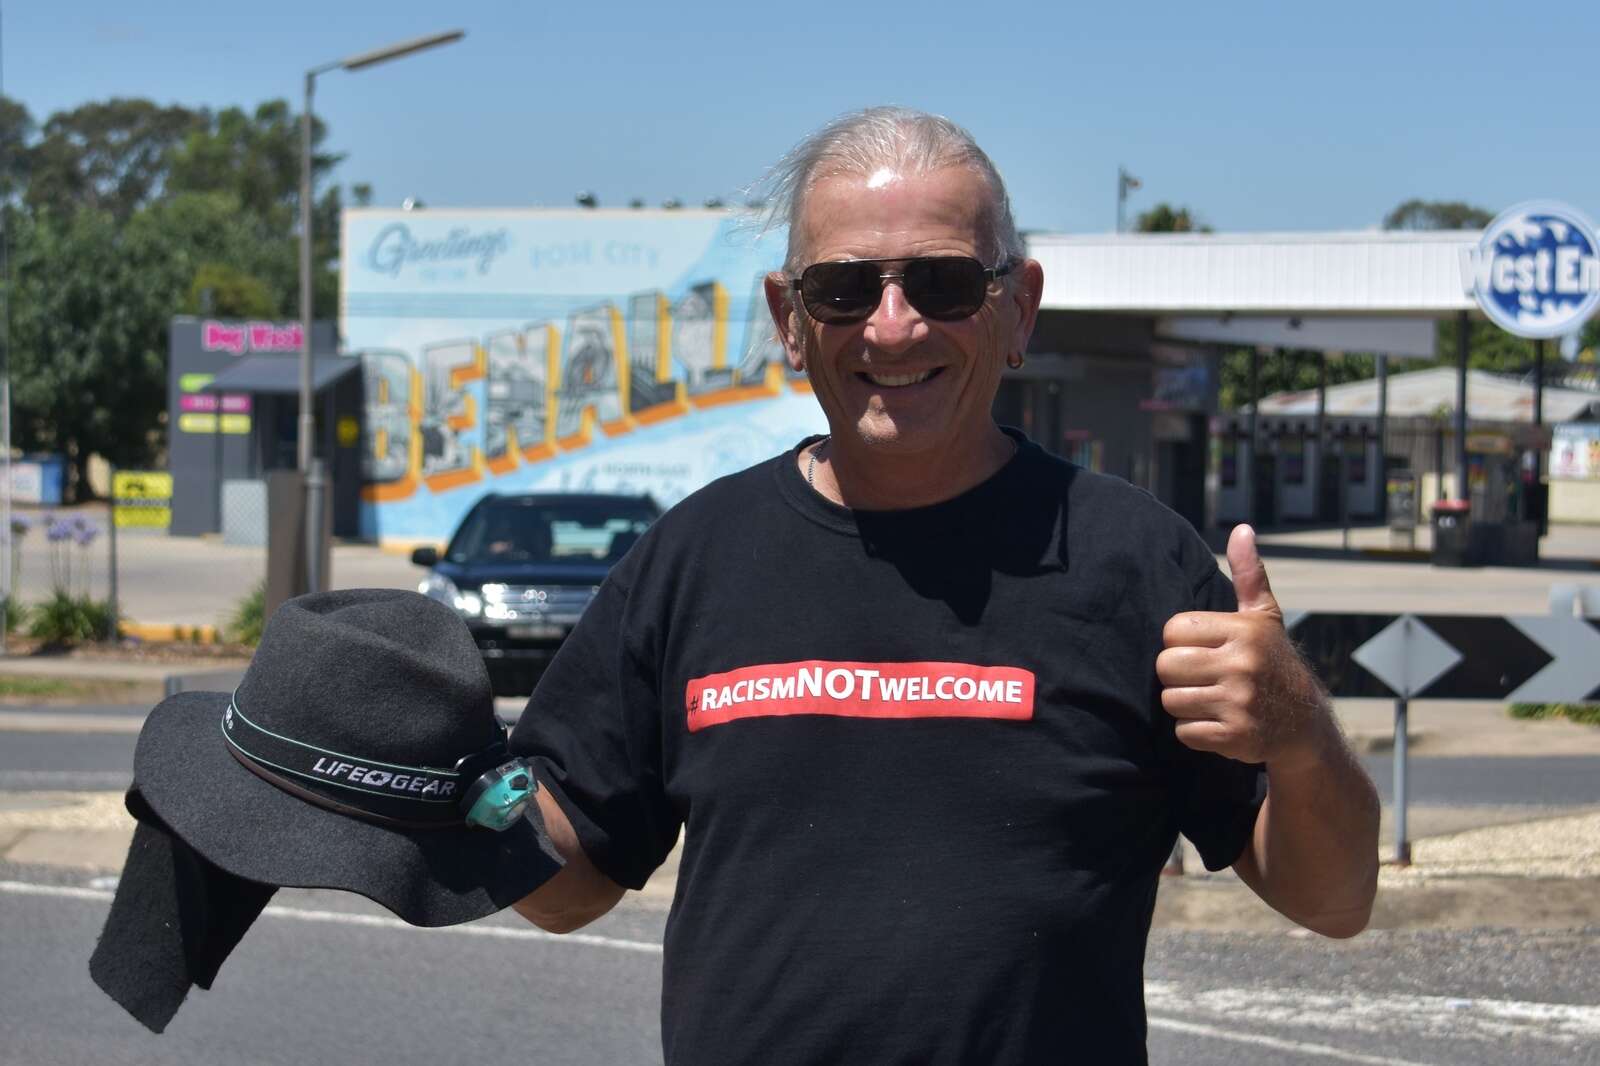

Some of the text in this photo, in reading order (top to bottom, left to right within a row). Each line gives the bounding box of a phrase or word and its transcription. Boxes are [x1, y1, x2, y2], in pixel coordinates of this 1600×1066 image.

[367, 221, 509, 279] Greetings
[202, 320, 247, 354] Dog
[312, 757, 456, 796] LIFE GEAR
